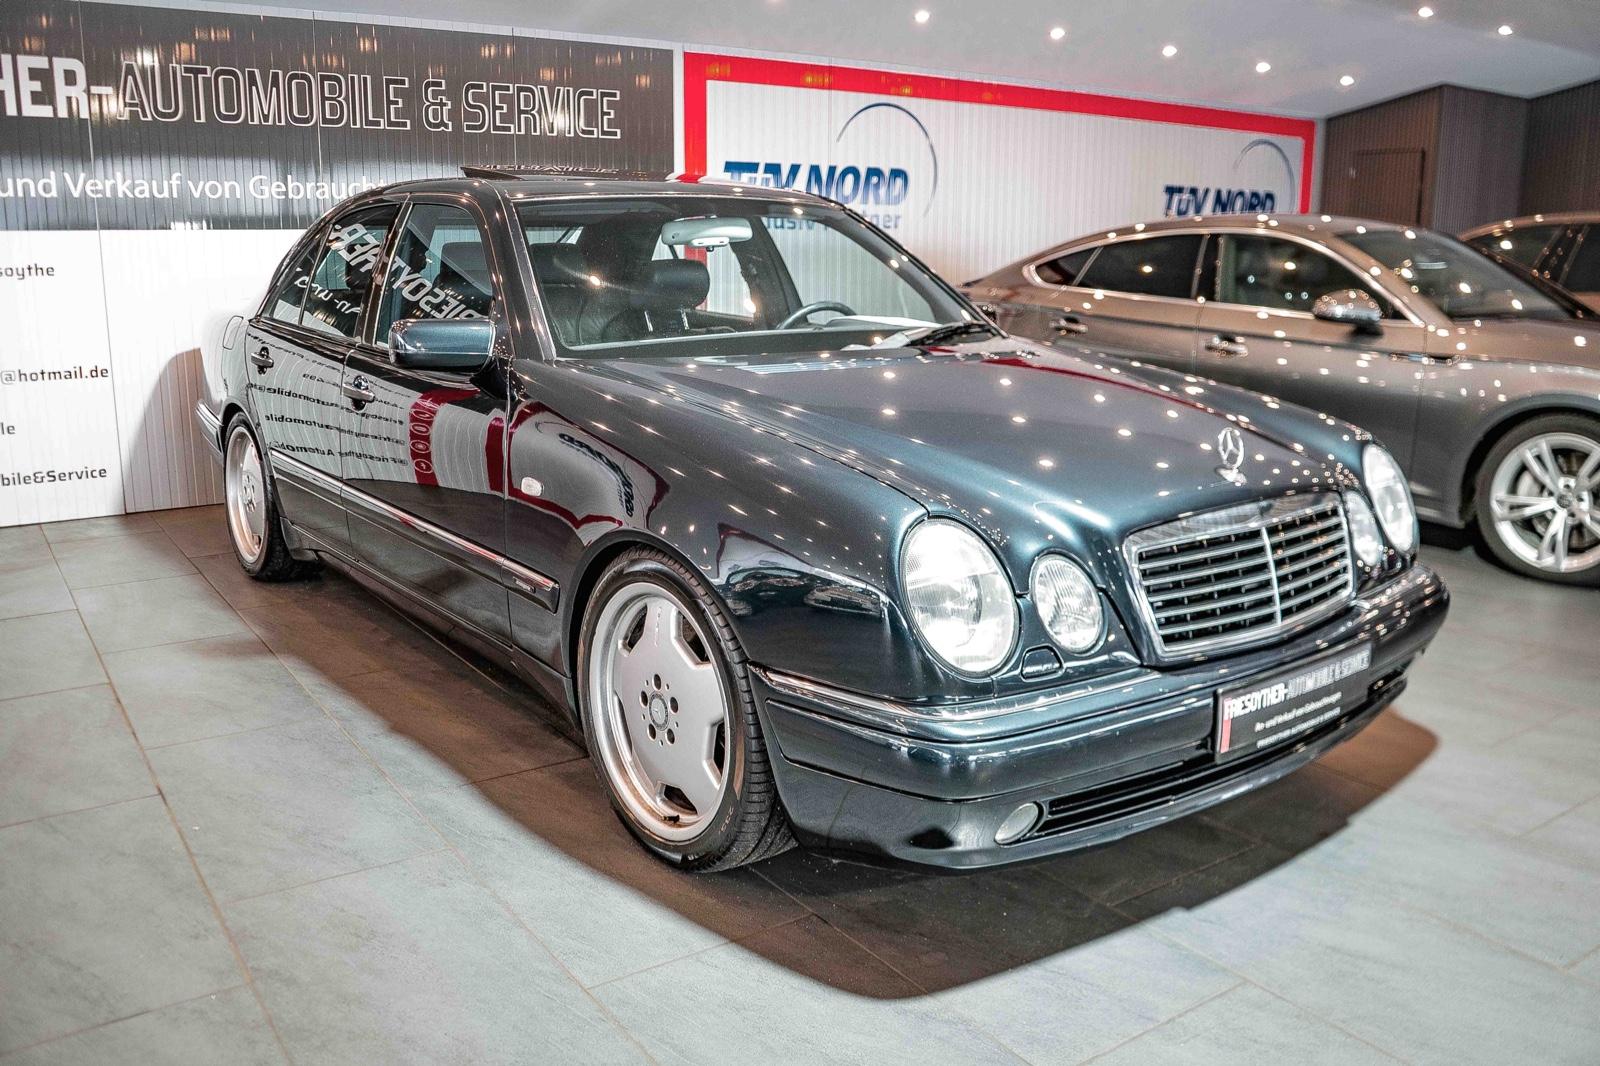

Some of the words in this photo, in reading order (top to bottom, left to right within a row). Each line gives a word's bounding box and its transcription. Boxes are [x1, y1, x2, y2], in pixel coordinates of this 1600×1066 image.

[422, 79, 452, 131] &
[463, 81, 621, 139] SERVICE
[0, 171, 57, 198] und
[63, 172, 181, 199] Verkauf
[188, 180, 241, 199] von
[805, 164, 909, 205] NORD
[1164, 184, 1210, 216] TÜV
[1212, 188, 1275, 215] NORD
[0, 366, 109, 385] @hotmail.de
[0, 466, 107, 487] bile&Service
